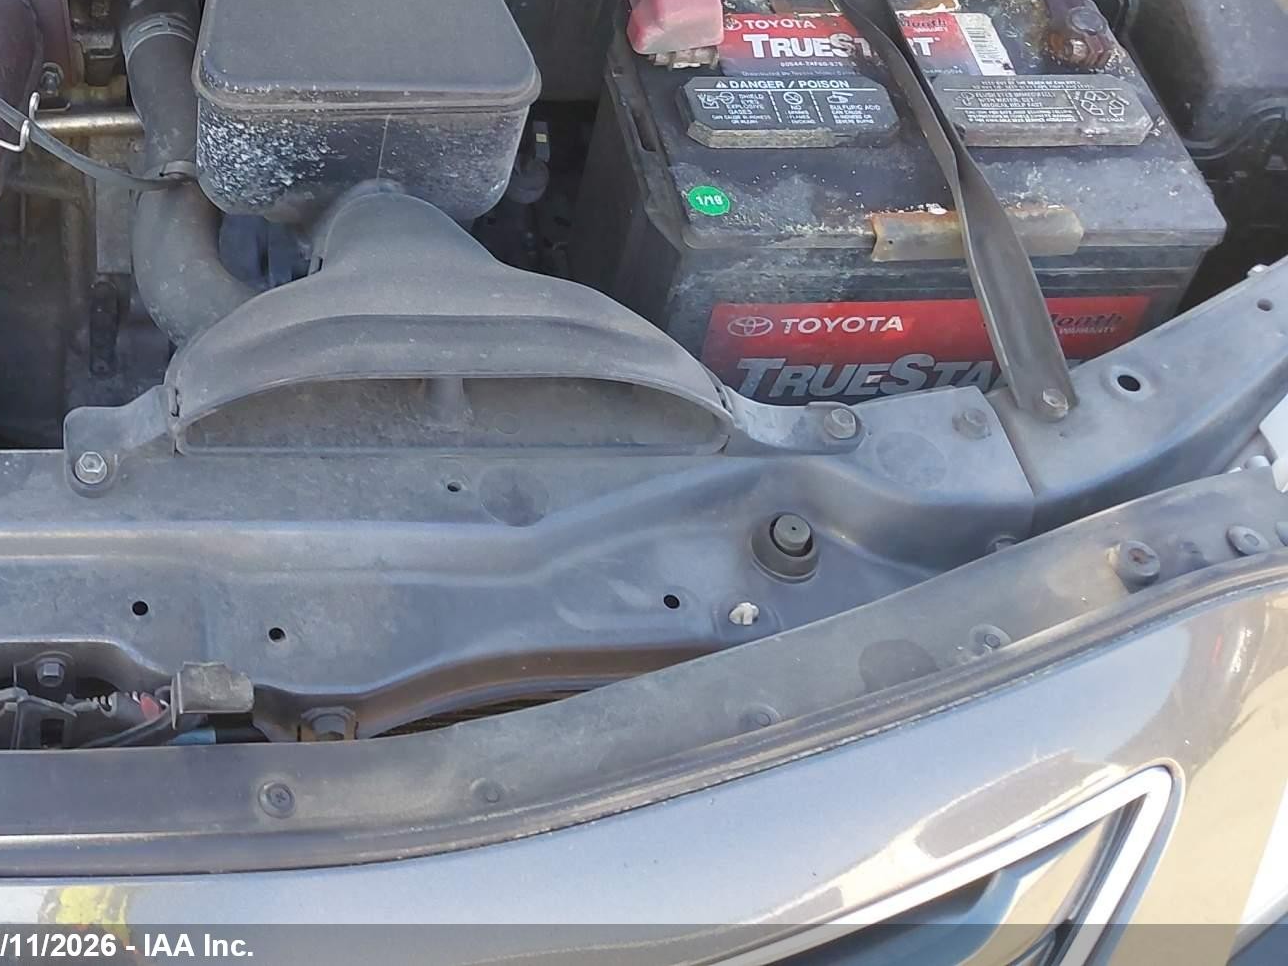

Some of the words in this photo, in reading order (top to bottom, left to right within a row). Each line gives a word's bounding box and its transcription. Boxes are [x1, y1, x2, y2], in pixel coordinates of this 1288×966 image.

[743, 18, 816, 30] TOYOTA
[728, 80, 786, 89] DANGER
[787, 80, 795, 89] /
[798, 80, 850, 89] POISON
[780, 315, 904, 334] TOYOTA
